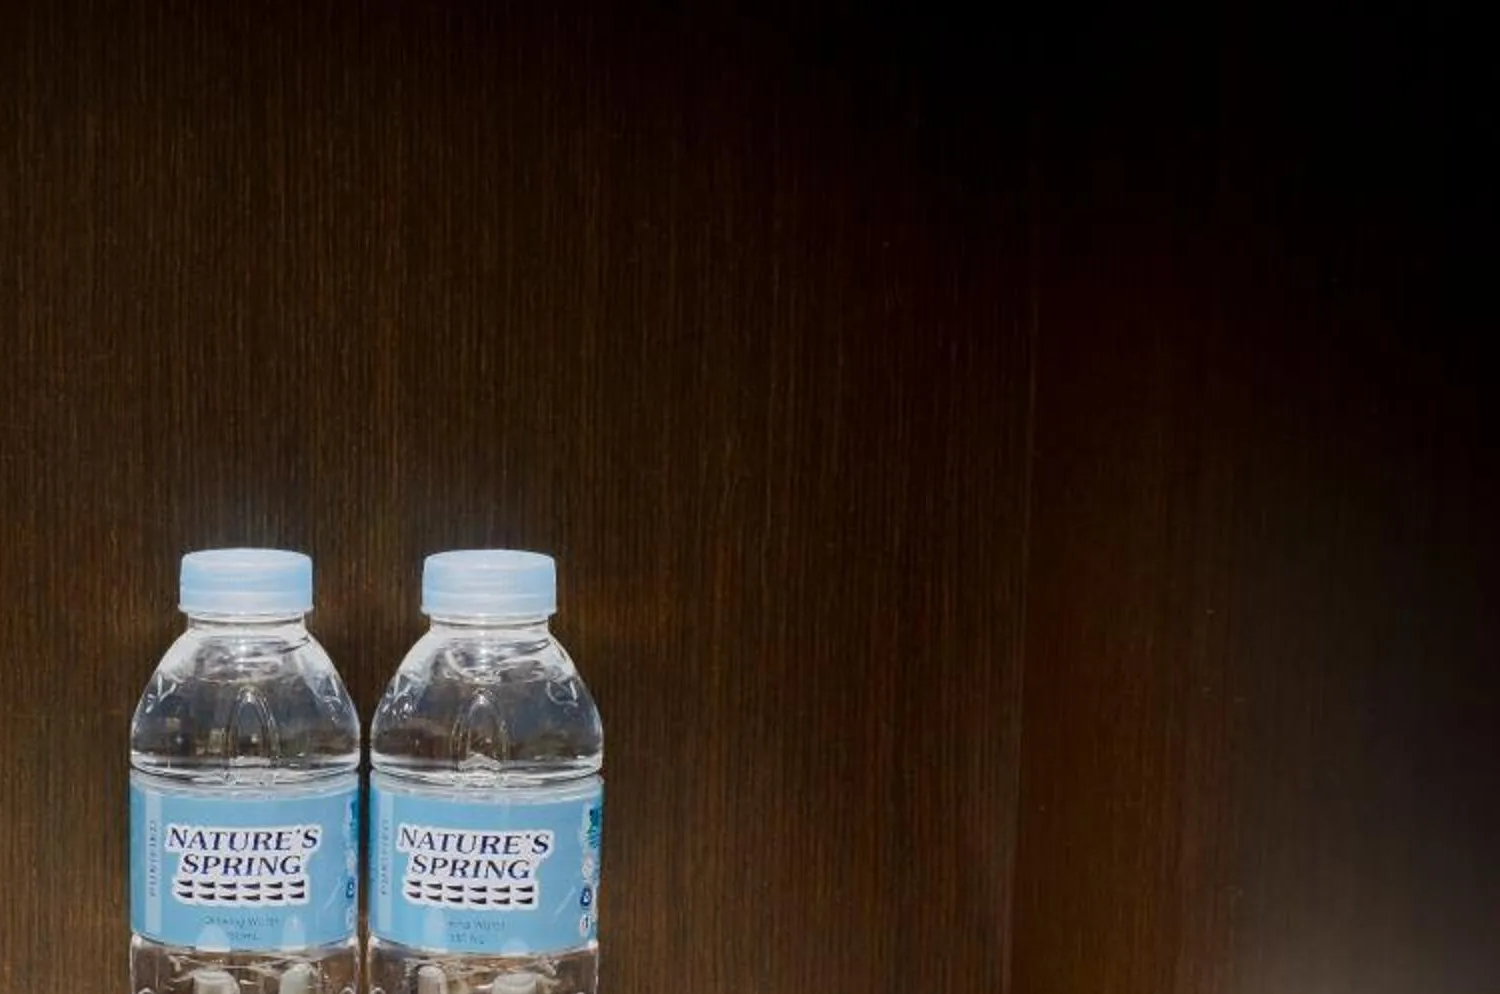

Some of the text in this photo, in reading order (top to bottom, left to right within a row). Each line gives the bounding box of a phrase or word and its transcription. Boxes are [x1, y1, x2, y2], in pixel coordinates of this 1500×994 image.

[168, 826, 319, 851] NATURE'S
[399, 827, 549, 855] NATURE'S
[181, 853, 303, 876] SPRING
[411, 854, 531, 879] SPRING
